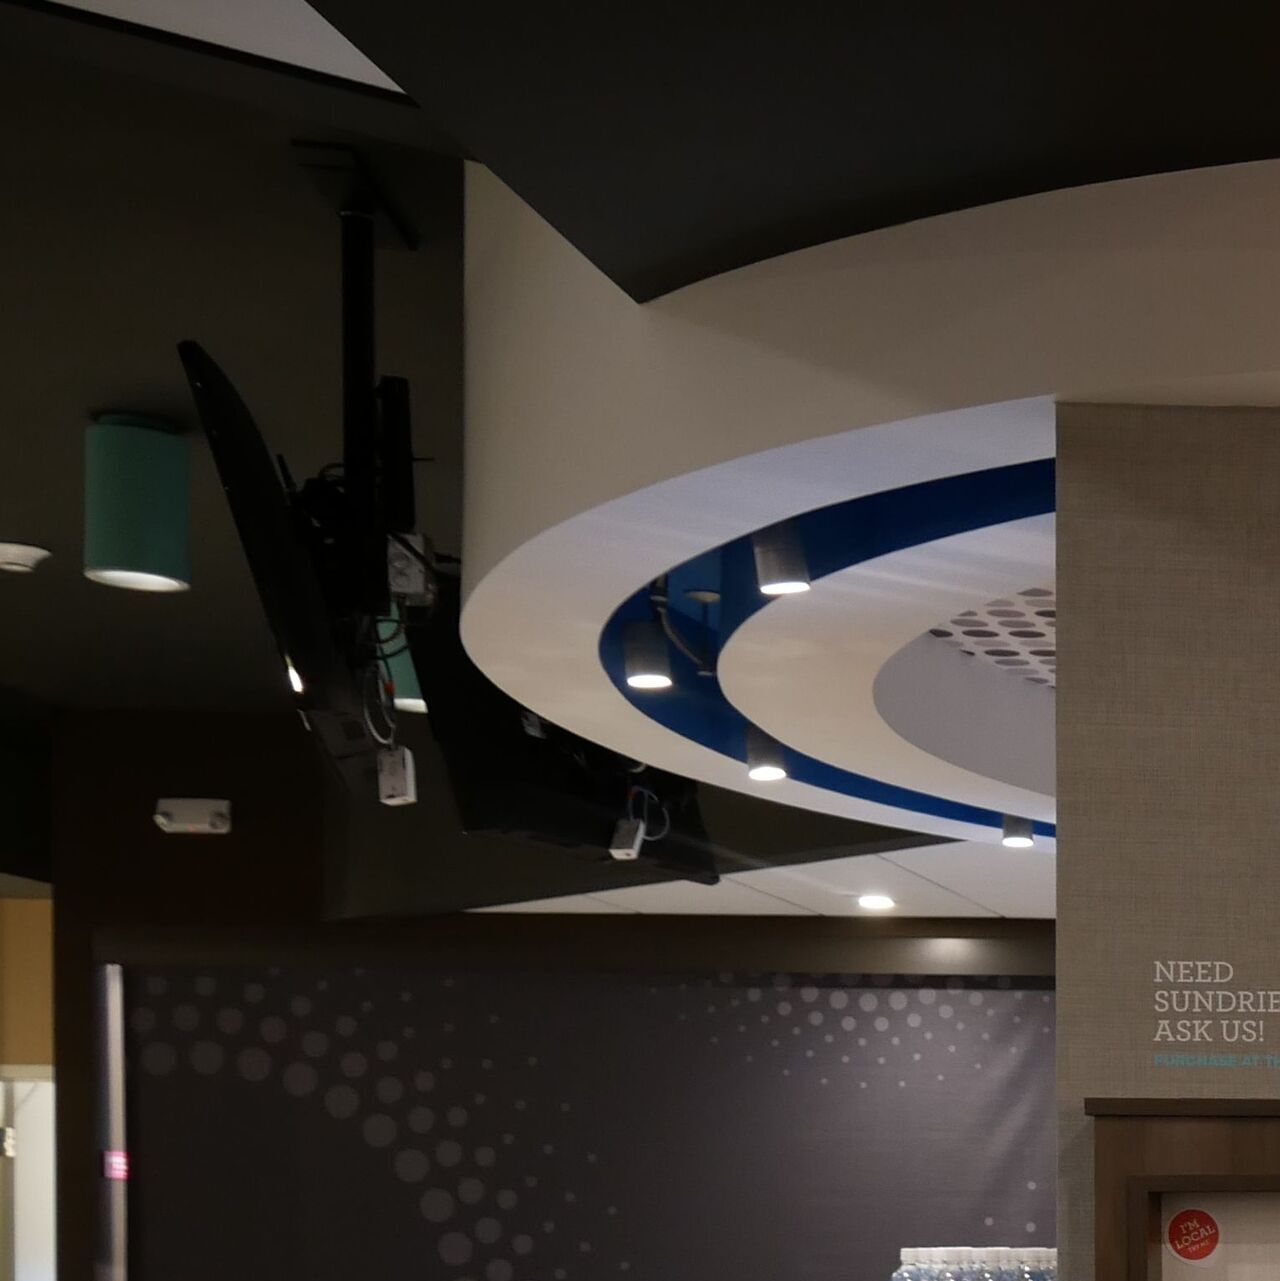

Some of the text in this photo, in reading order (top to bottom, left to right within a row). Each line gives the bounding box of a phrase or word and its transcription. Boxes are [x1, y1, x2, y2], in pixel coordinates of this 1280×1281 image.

[1154, 961, 1234, 983] NEED
[1153, 1020, 1264, 1042] ASK US!
[1154, 1054, 1237, 1067] PURCHASE
[1242, 1055, 1261, 1067] AT
[1174, 1225, 1217, 1250] LOCAL
[1179, 1218, 1200, 1235] I'M
